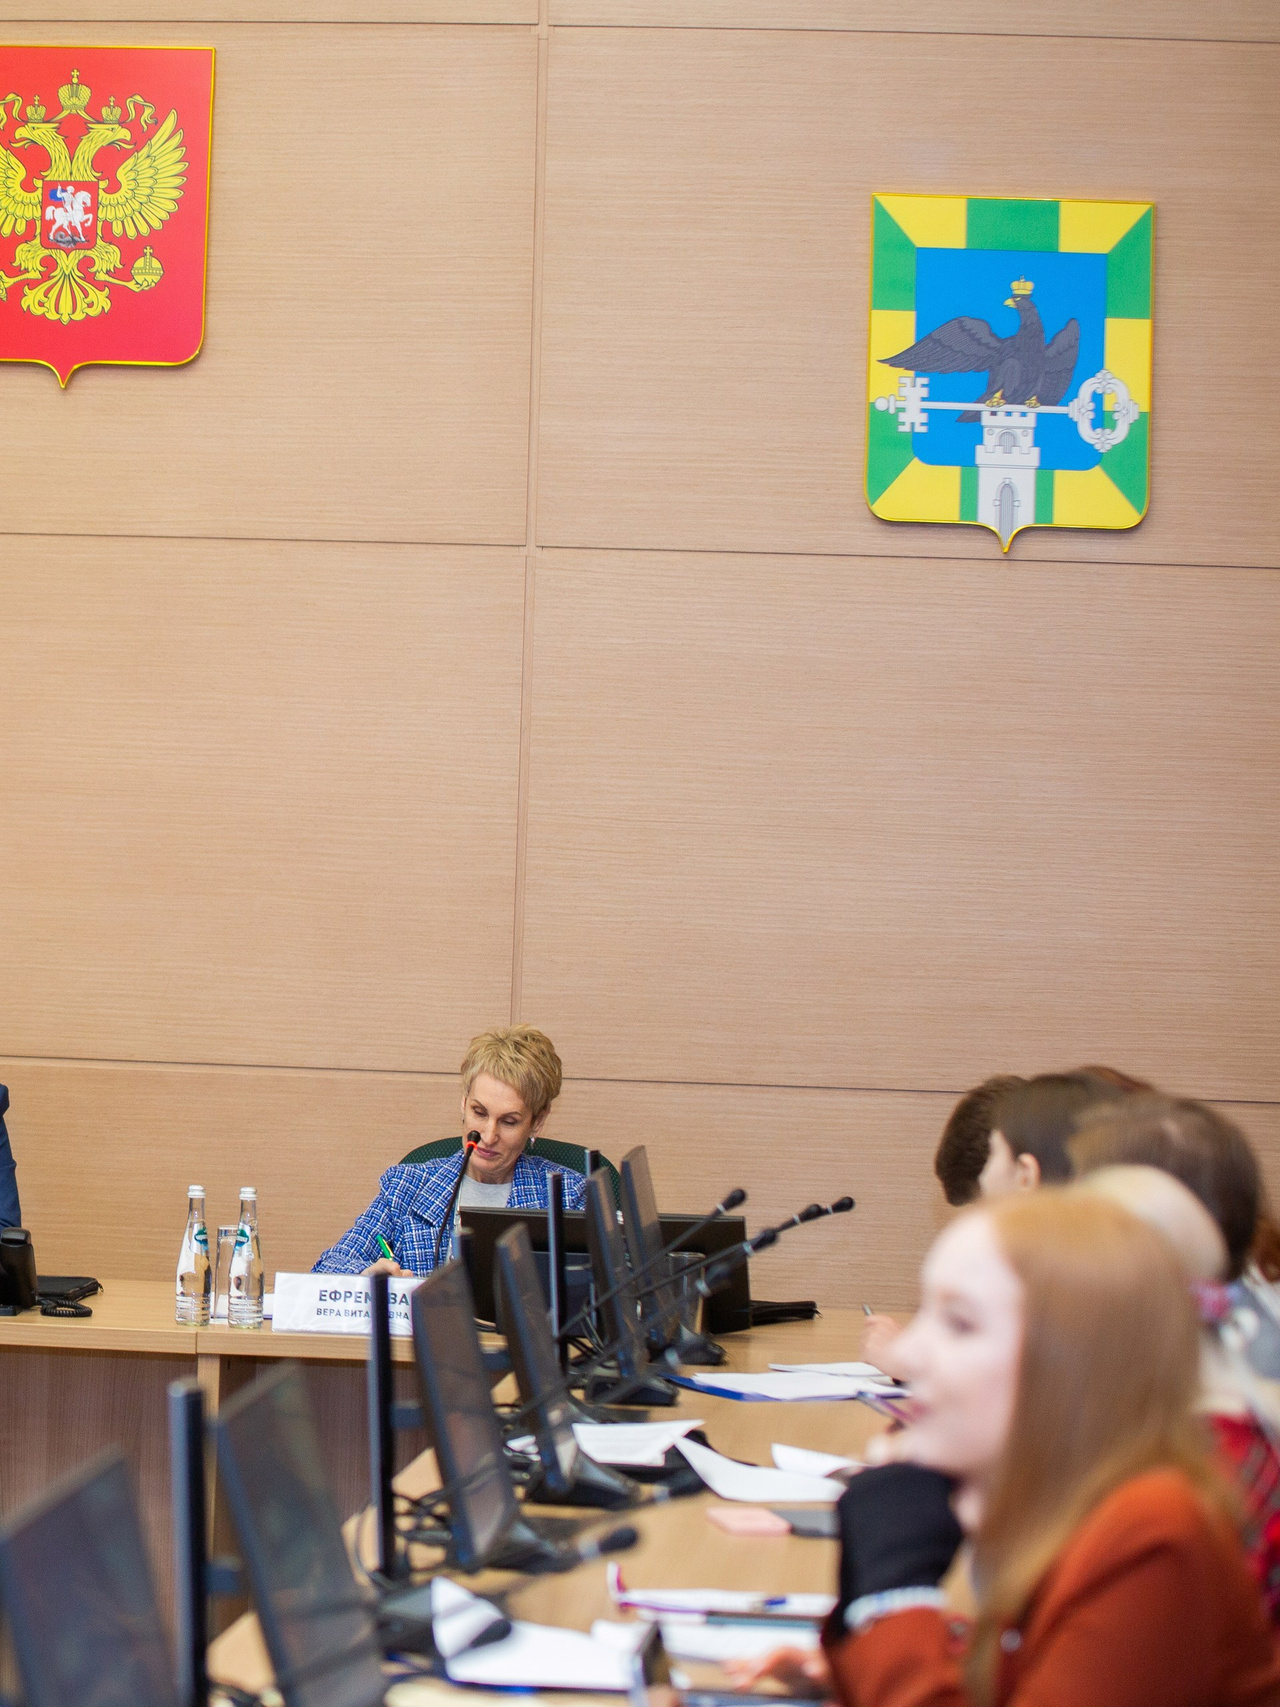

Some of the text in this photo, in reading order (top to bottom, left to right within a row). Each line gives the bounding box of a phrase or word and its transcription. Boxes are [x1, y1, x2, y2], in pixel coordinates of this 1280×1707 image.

[319, 1289, 410, 1306] ЕФРЕМВА
[316, 1308, 410, 1320] ВЕРА ВИТАВНА
